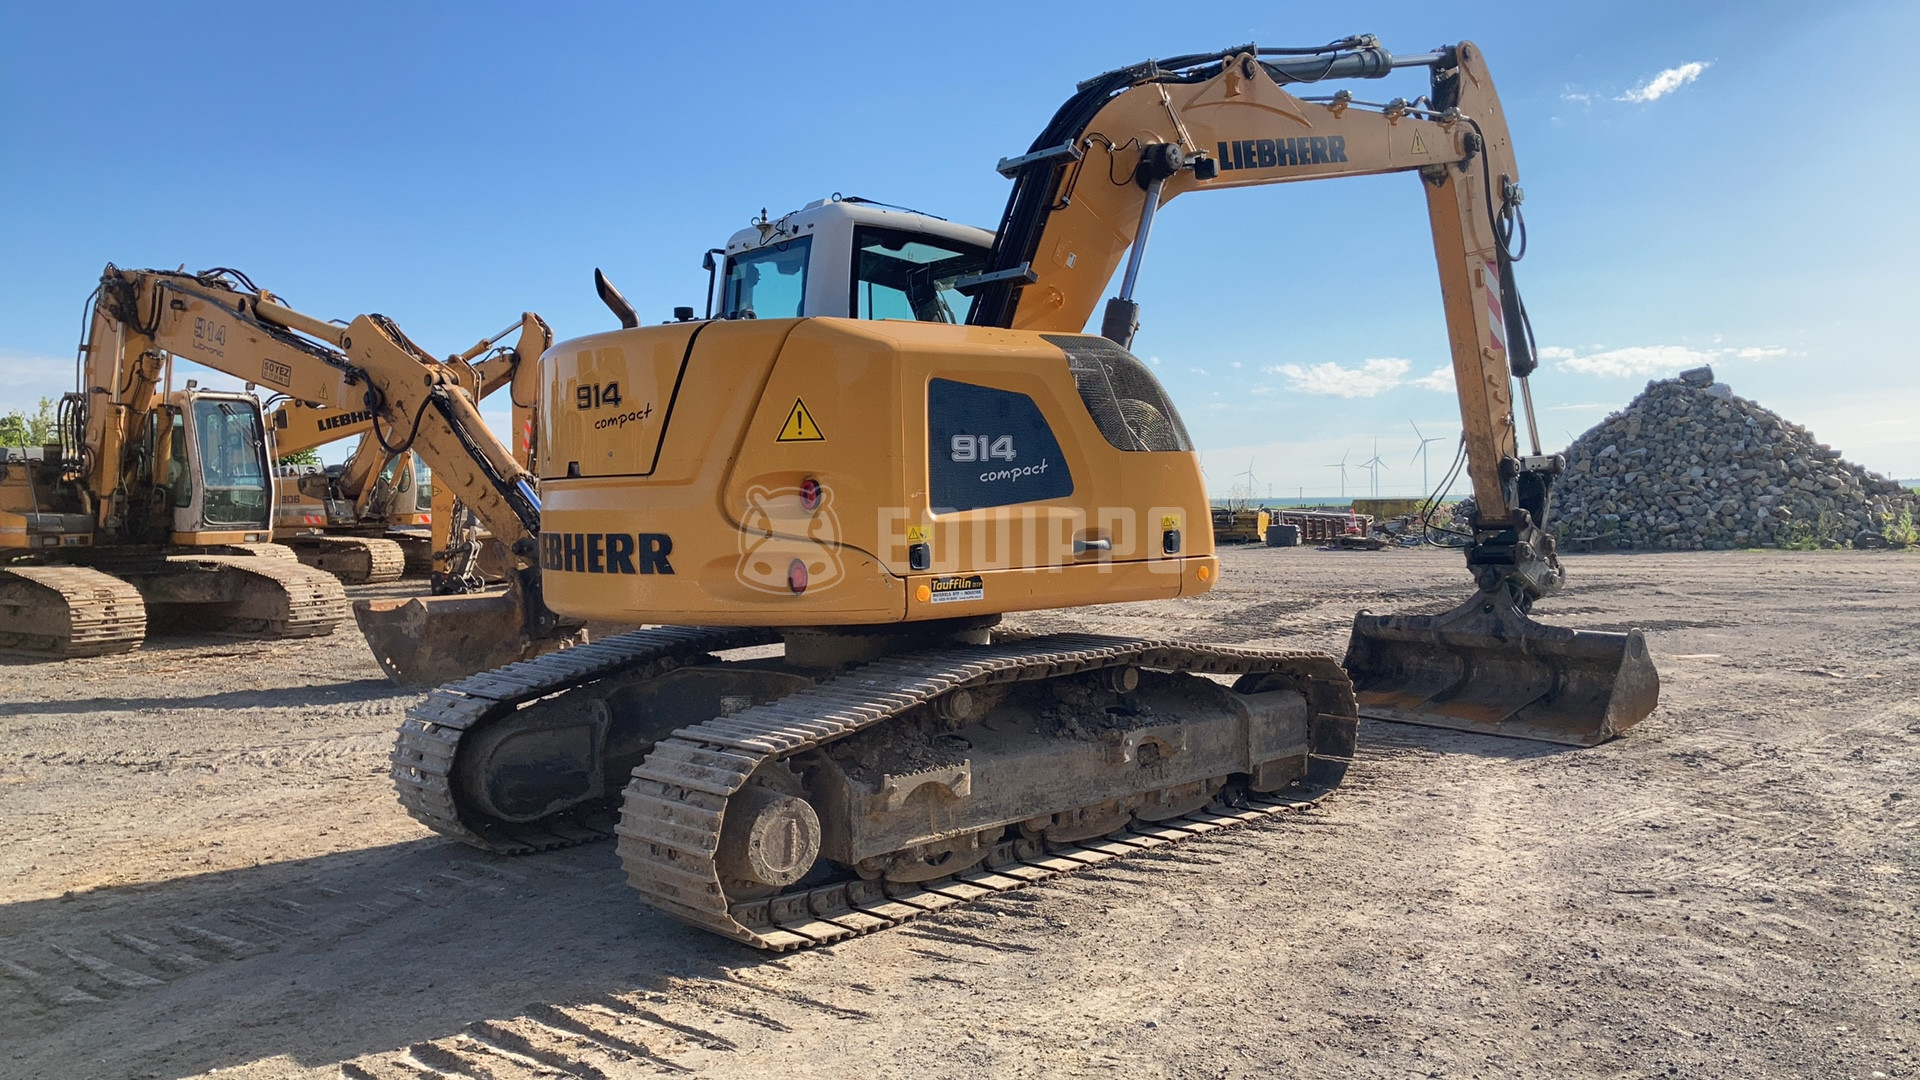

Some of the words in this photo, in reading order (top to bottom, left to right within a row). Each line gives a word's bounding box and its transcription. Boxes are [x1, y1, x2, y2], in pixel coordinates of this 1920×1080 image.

[1217, 135, 1348, 170] LIEBHERR
[194, 317, 226, 346] 914
[264, 361, 289, 378] SOYEZ
[576, 381, 622, 411] 914
[317, 411, 373, 432] LIEBHE
[594, 402, 653, 430] compact
[951, 434, 1017, 462] 914
[979, 458, 1048, 482] compact
[932, 578, 971, 591] Toufflin
